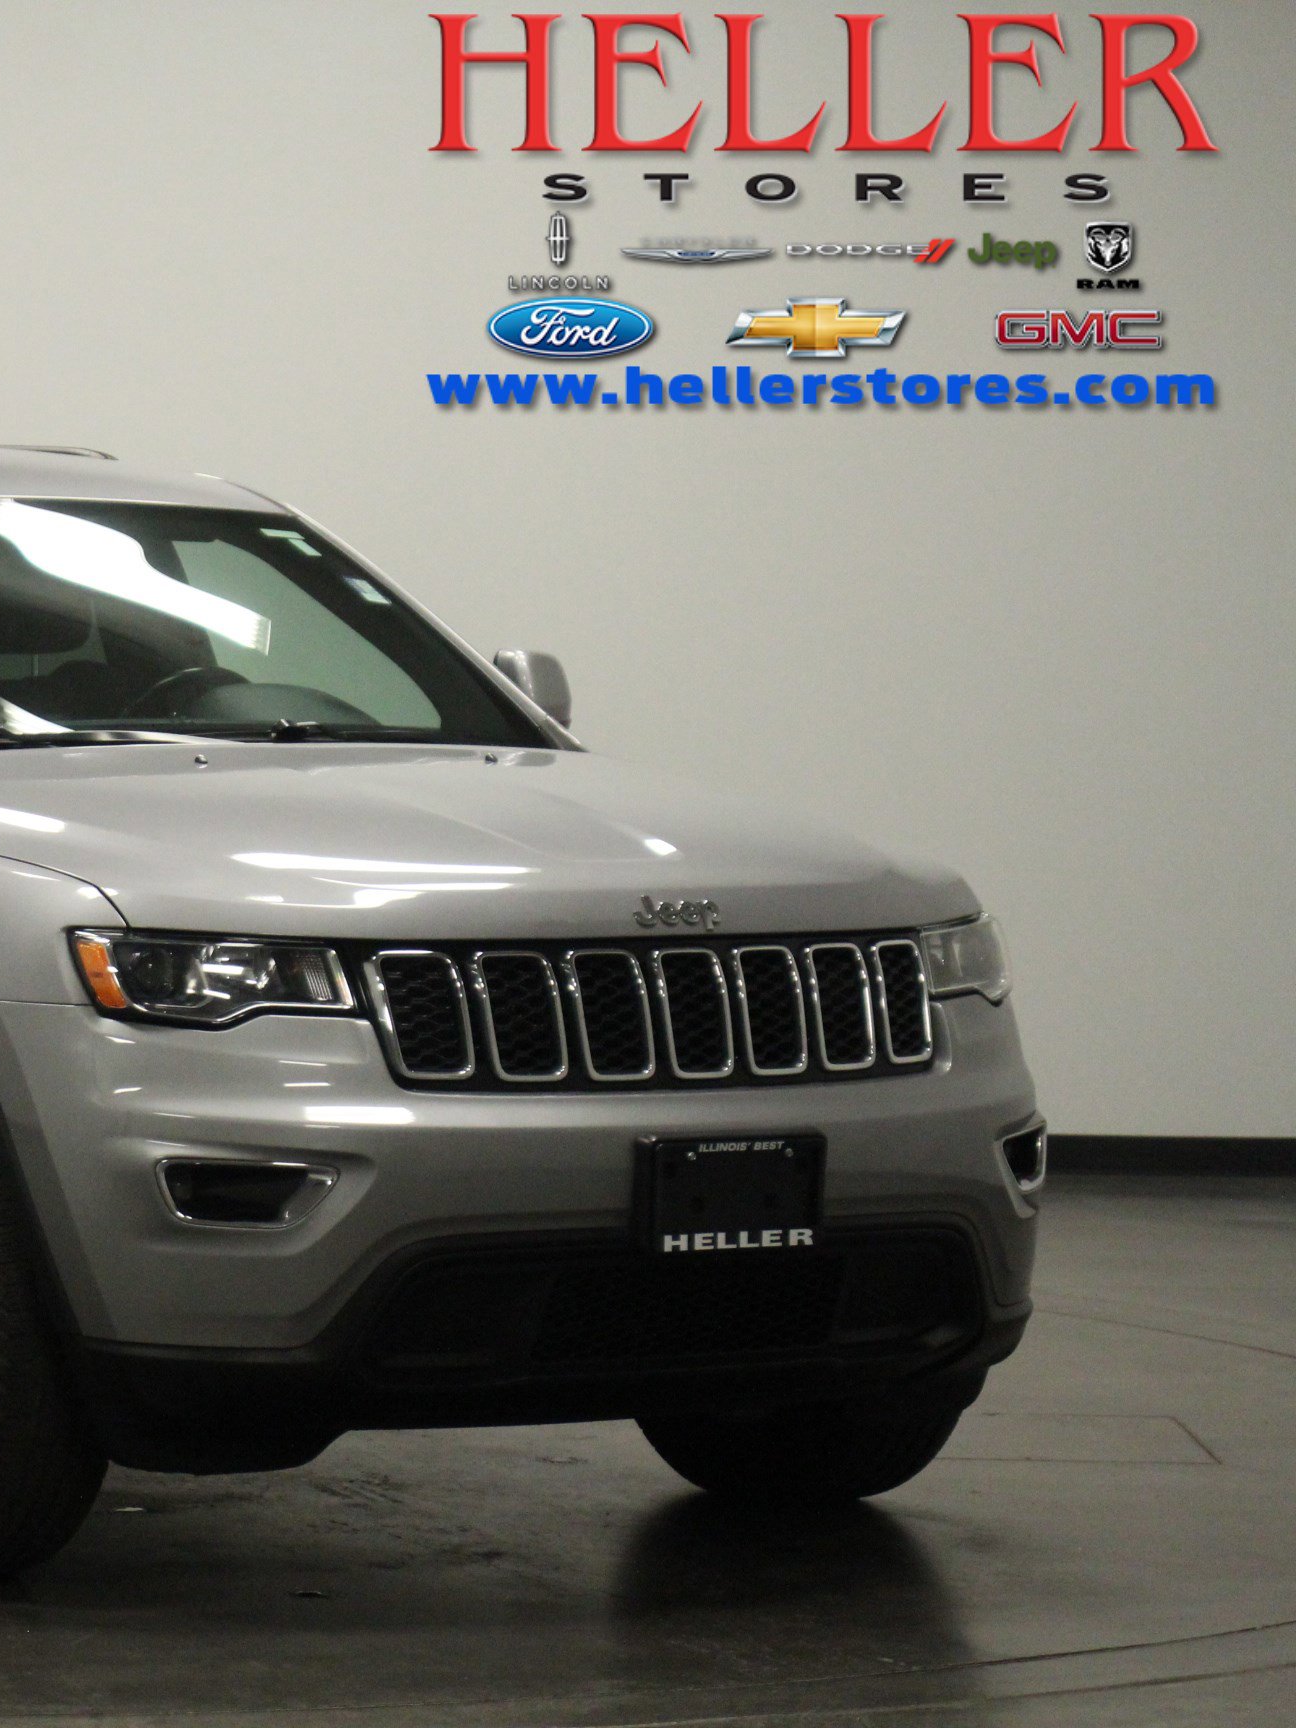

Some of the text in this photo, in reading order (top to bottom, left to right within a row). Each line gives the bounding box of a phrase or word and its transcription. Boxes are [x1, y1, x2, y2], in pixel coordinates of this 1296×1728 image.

[632, 895, 721, 931] Jeep
[754, 1141, 785, 1151] BEST
[663, 1229, 814, 1253] HELLER
